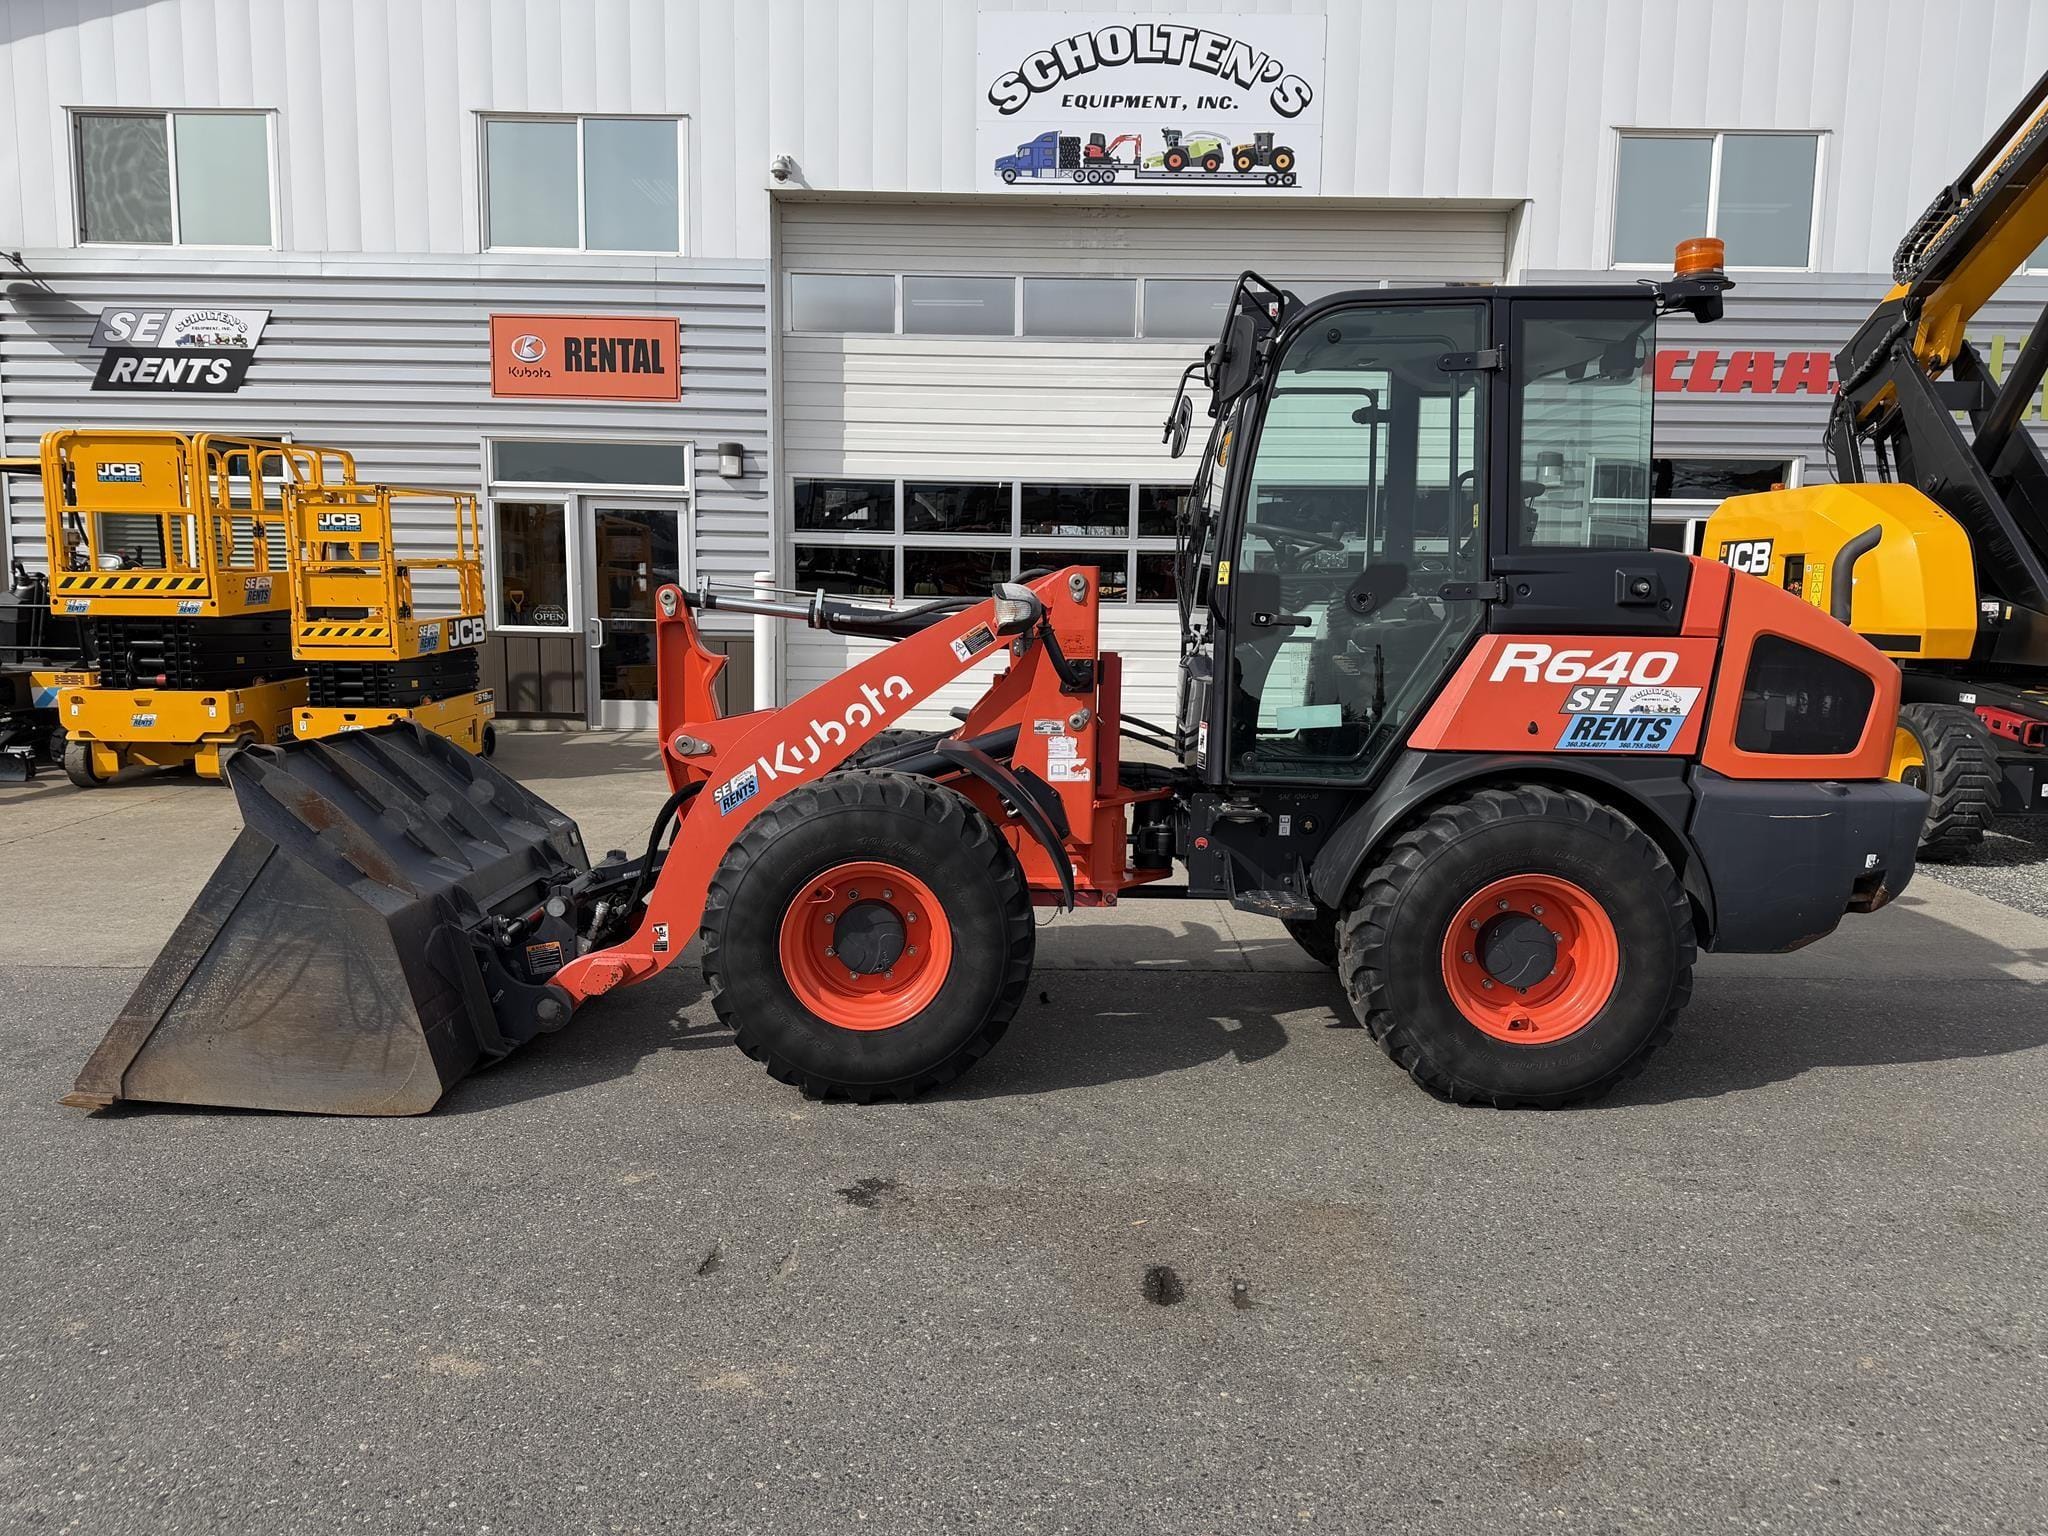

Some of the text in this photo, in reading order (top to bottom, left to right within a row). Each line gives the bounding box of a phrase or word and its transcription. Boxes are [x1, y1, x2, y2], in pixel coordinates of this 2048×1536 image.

[988, 24, 1313, 118] SCHOLTEN'S
[1061, 94, 1239, 111] EQUIPMENT, INC.
[104, 312, 166, 342] SE
[175, 311, 248, 333] SCHOLTEN'S
[564, 336, 665, 374] RENTAL
[108, 356, 232, 385] RENTS
[508, 366, 551, 378] Kubota
[1655, 350, 1839, 394] CLAA
[98, 463, 141, 476] JCB
[319, 513, 361, 526] JCB
[1720, 541, 1771, 574] JCB
[245, 578, 256, 589] SE
[535, 612, 564, 621] OPEN
[419, 625, 428, 637] SE
[450, 618, 485, 647] JCB
[1489, 643, 1679, 685] R640
[1567, 688, 1620, 712] SE
[758, 675, 914, 781] Kubota
[1570, 716, 1672, 742] RENTS
[714, 782, 731, 802] SE
[722, 780, 756, 811] RENTS
